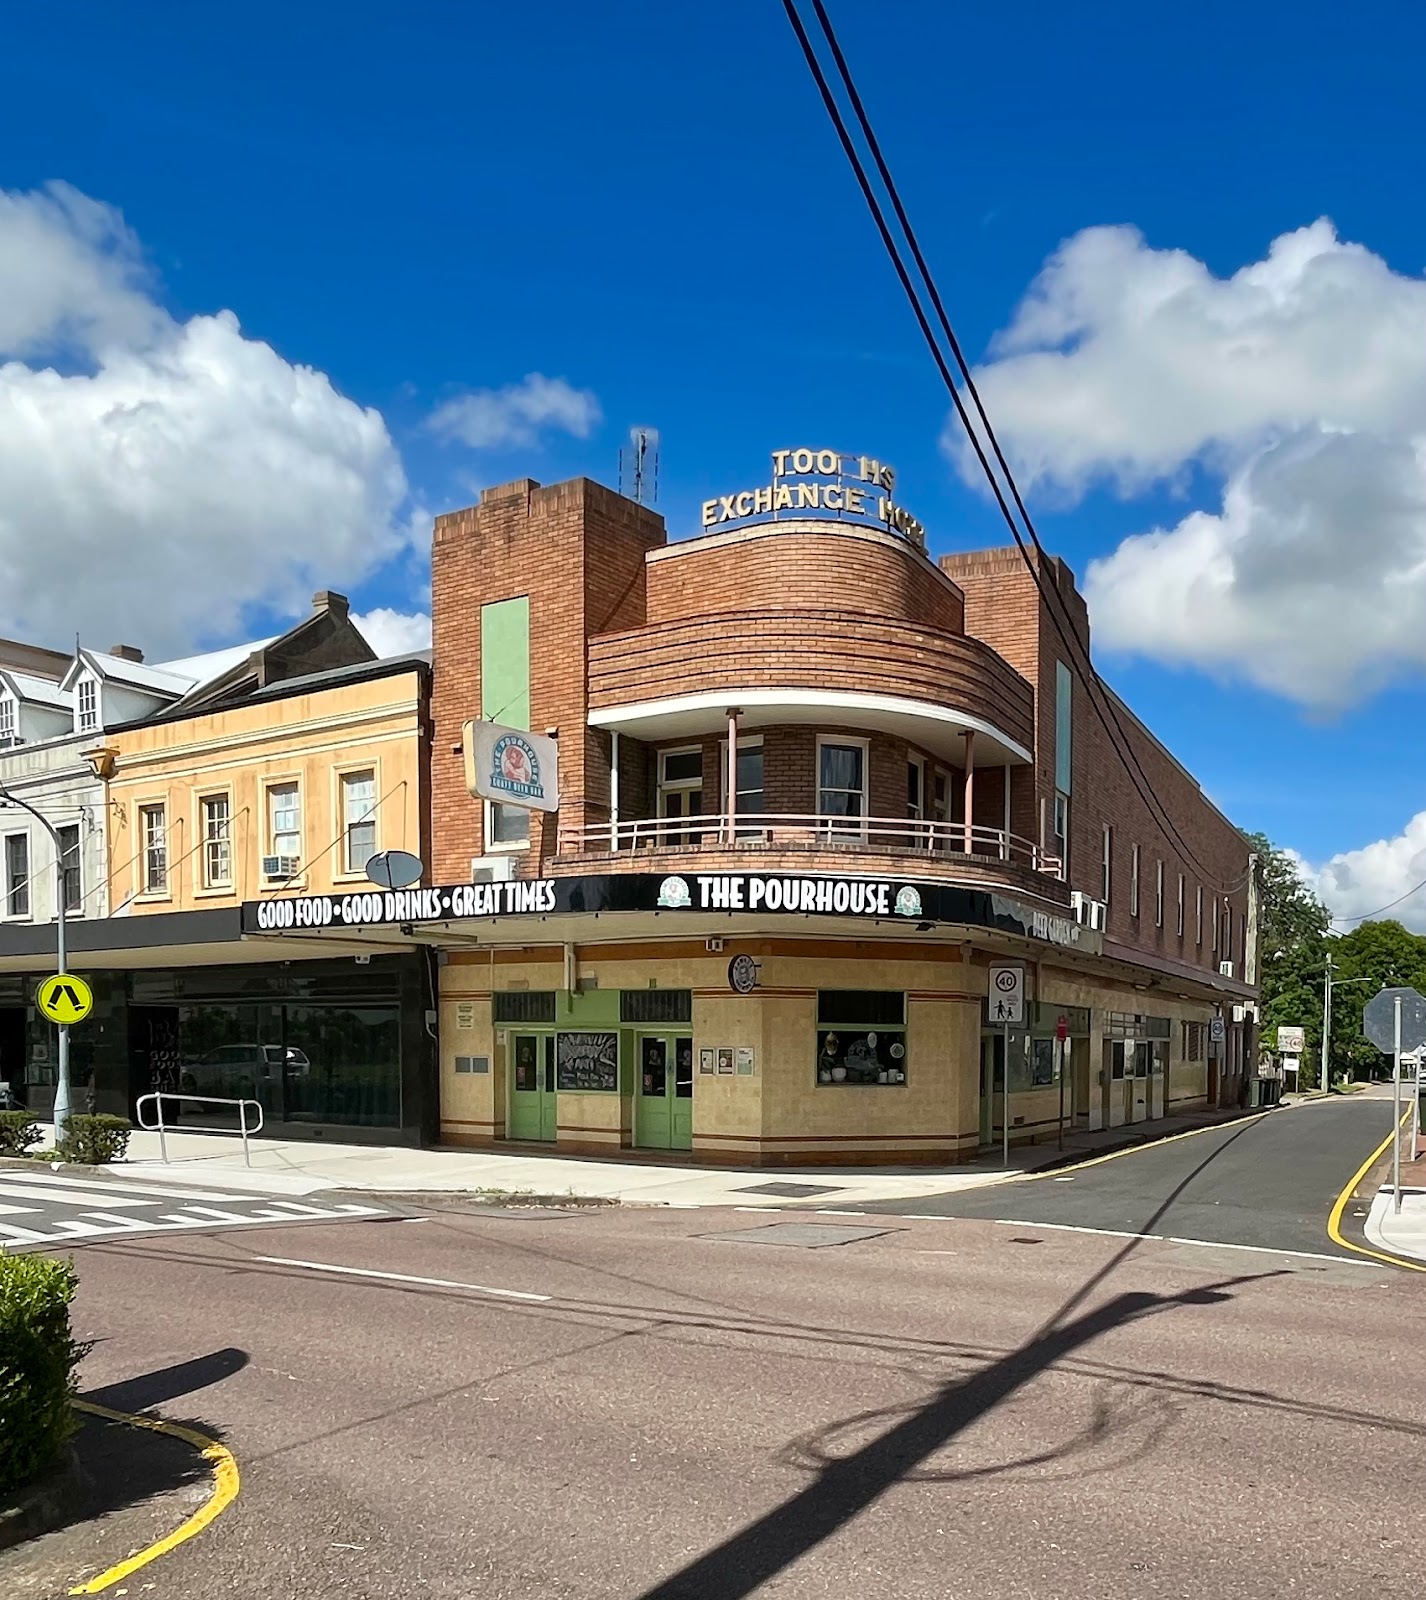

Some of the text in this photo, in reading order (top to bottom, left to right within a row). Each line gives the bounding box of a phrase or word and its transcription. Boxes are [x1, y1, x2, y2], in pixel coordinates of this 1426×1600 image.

[772, 448, 841, 477] TOO
[702, 482, 866, 526] EXCHANGE
[257, 880, 556, 928] GOOD FOOD GOOD DRINKS GREAT TIMES
[697, 876, 744, 909] THE
[749, 878, 889, 914] POURHOUSE
[999, 976, 1013, 987] 40
